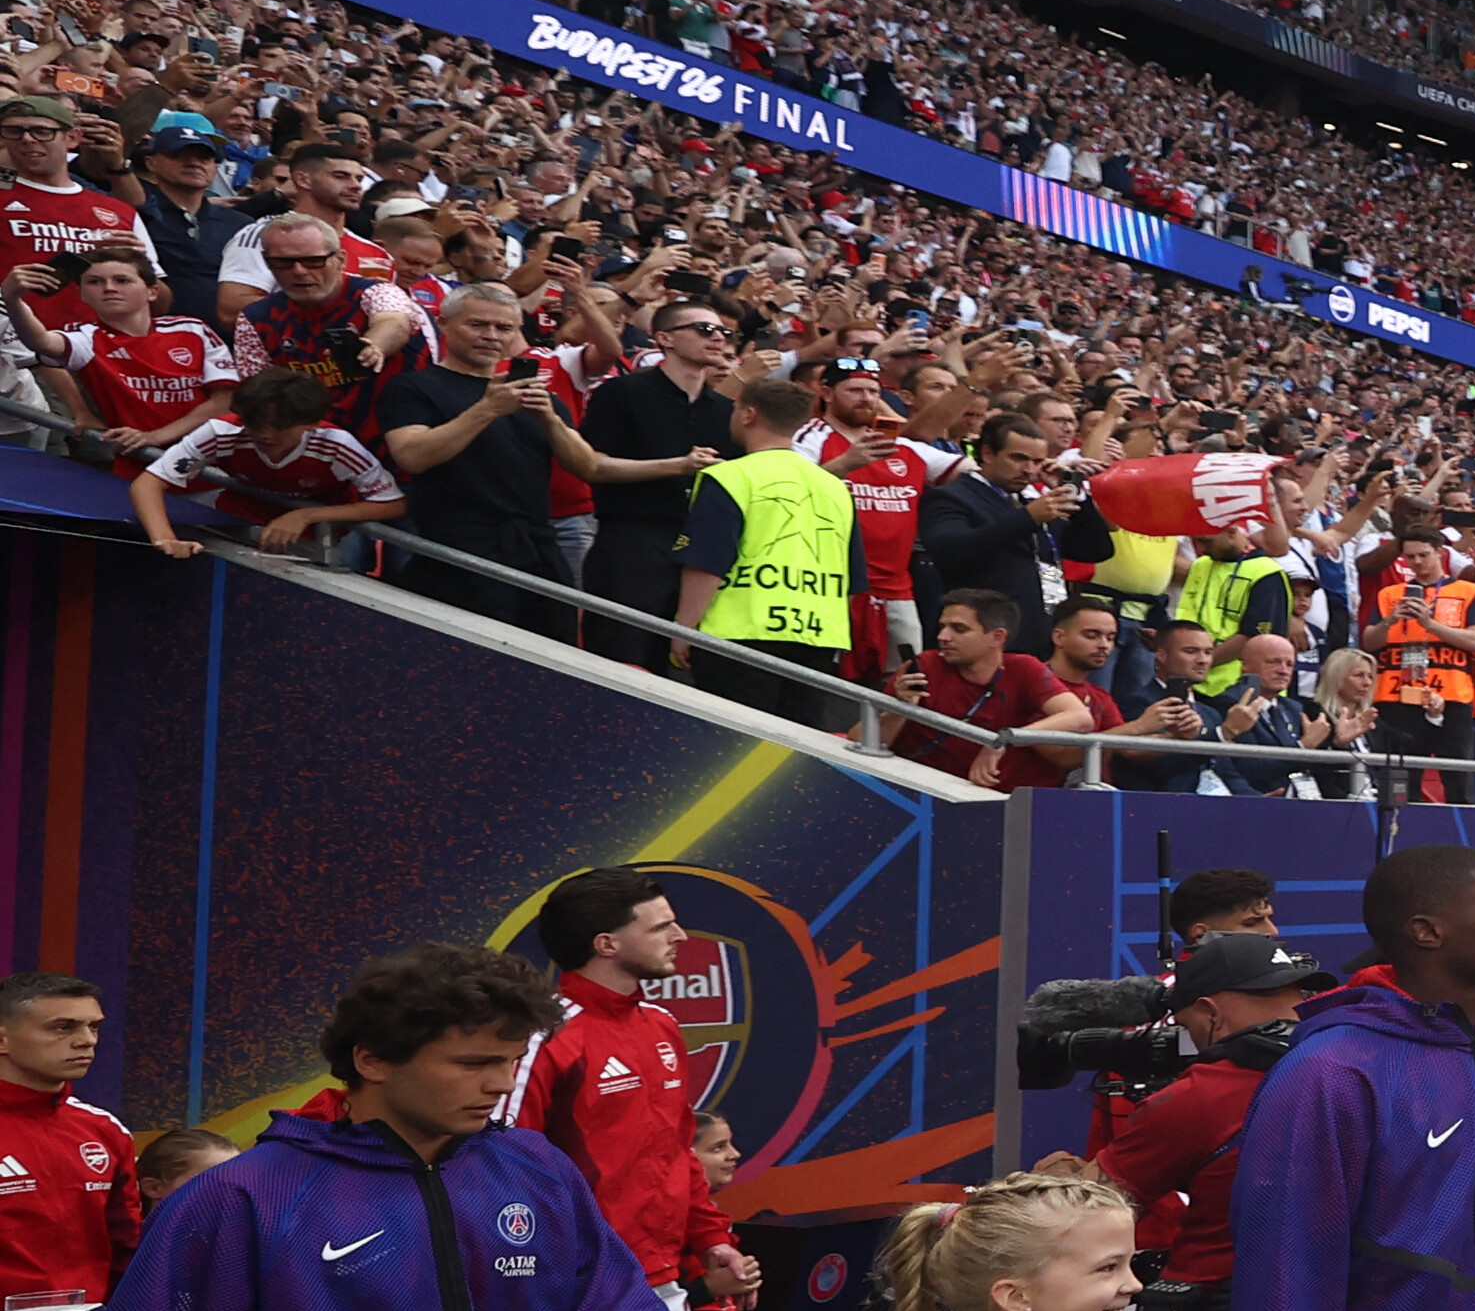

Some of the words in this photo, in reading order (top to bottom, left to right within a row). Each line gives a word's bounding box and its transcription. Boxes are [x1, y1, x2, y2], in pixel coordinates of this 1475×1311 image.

[527, 14, 686, 91] BUDAPEST
[734, 83, 854, 151] FINAL
[1417, 84, 1455, 107] UEFA
[34, 236, 61, 252] FLY
[1368, 302, 1430, 344] PEPSI
[119, 372, 207, 391] mirates
[718, 563, 844, 598] SECURIT
[766, 606, 823, 638] 534
[641, 964, 722, 1002] enal
[504, 1204, 530, 1216] PARIS
[495, 1255, 537, 1271] QATAR
